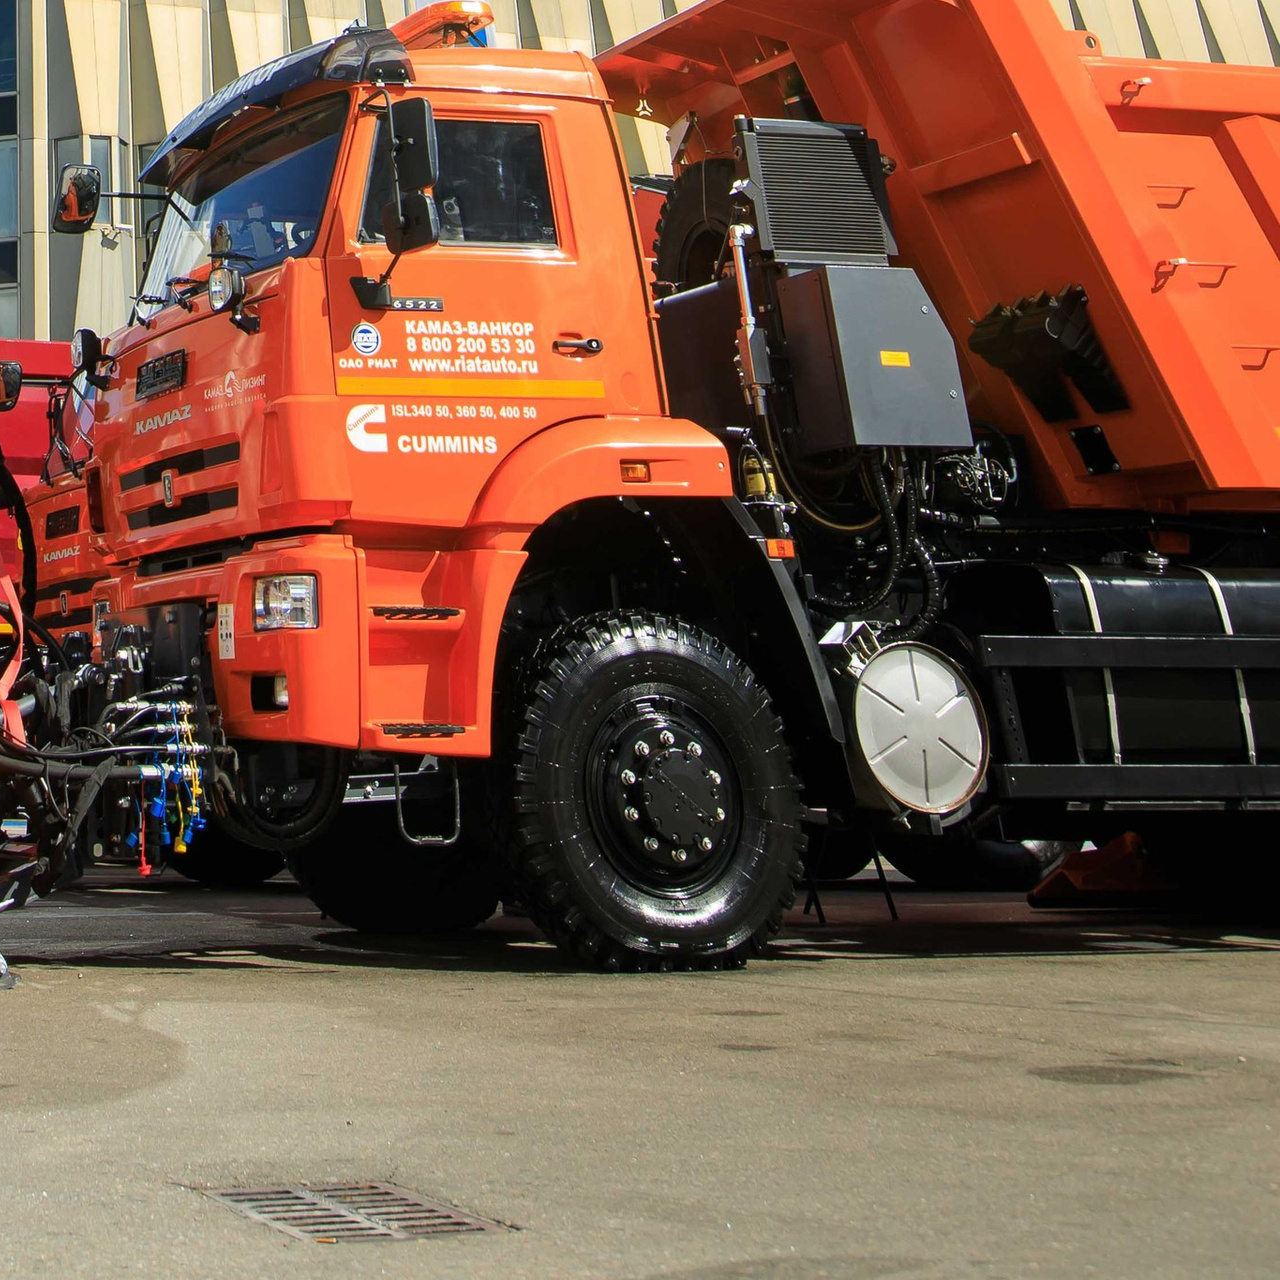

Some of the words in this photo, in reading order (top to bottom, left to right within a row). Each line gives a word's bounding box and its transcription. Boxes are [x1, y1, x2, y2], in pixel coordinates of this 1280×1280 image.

[393, 300, 438, 309] 6522
[404, 319, 535, 336] КАМАЗ-ВАНКОР
[406, 336, 417, 352] 8
[421, 336, 452, 352] 800
[456, 337, 487, 353] 200
[490, 337, 511, 354] 53
[514, 338, 535, 354] 30
[338, 358, 364, 368] ОАО
[367, 358, 398, 368] РИАТ
[408, 354, 539, 374] www.riatauto.ru
[135, 404, 192, 435] KAMAZ
[347, 406, 379, 432] Cummins
[391, 404, 432, 417] ISL340
[435, 405, 453, 419] 50,
[455, 405, 477, 418] 360
[479, 406, 497, 420] 50,
[499, 406, 520, 418] 400
[523, 406, 537, 419] 50
[397, 435, 498, 454] CUMMINS
[43, 545, 81, 563] KAMAZ
